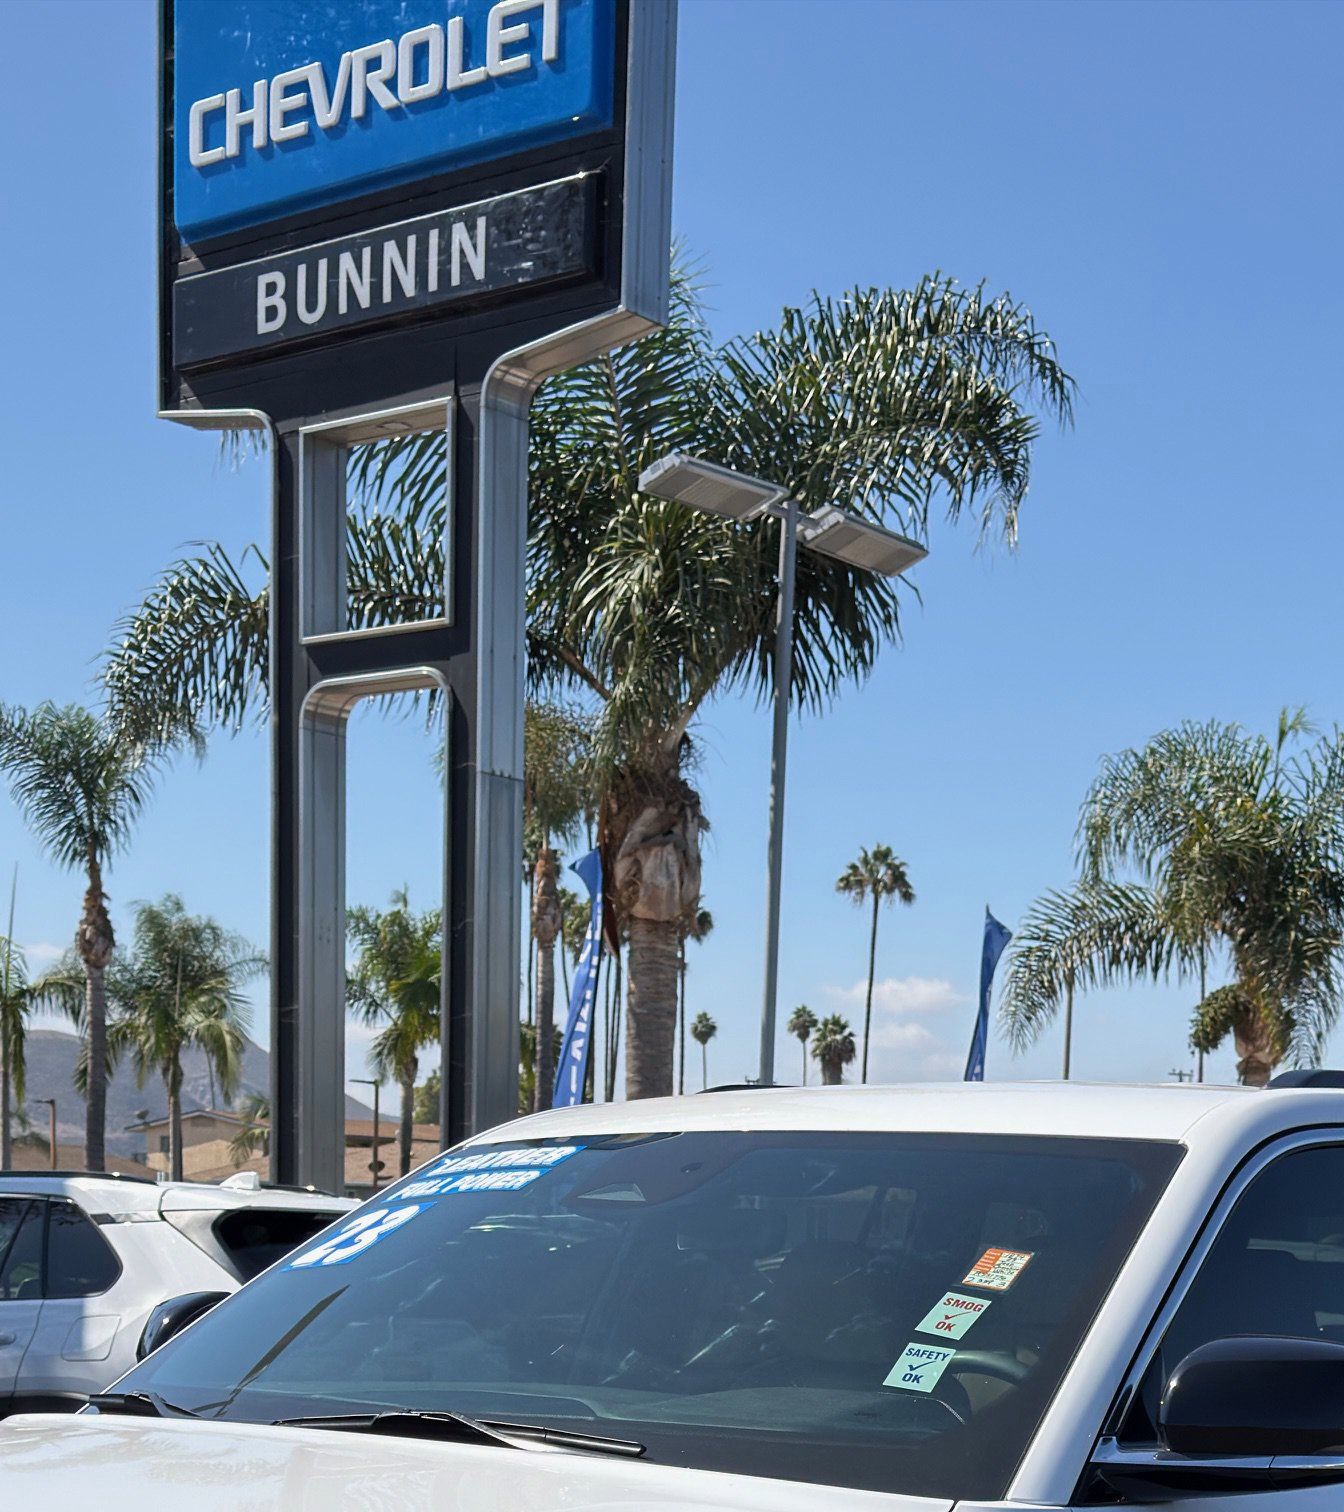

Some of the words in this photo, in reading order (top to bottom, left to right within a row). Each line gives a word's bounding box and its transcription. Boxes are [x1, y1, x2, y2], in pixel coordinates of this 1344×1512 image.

[188, 0, 561, 168] CHEVROLET
[257, 216, 487, 335] BUNNIN
[442, 1170, 541, 1193] POWER
[291, 1205, 421, 1268] 23
[943, 1297, 984, 1313] SMOG
[935, 1321, 956, 1333] OK
[905, 1347, 950, 1361] SAFETY
[901, 1373, 924, 1384] OK
